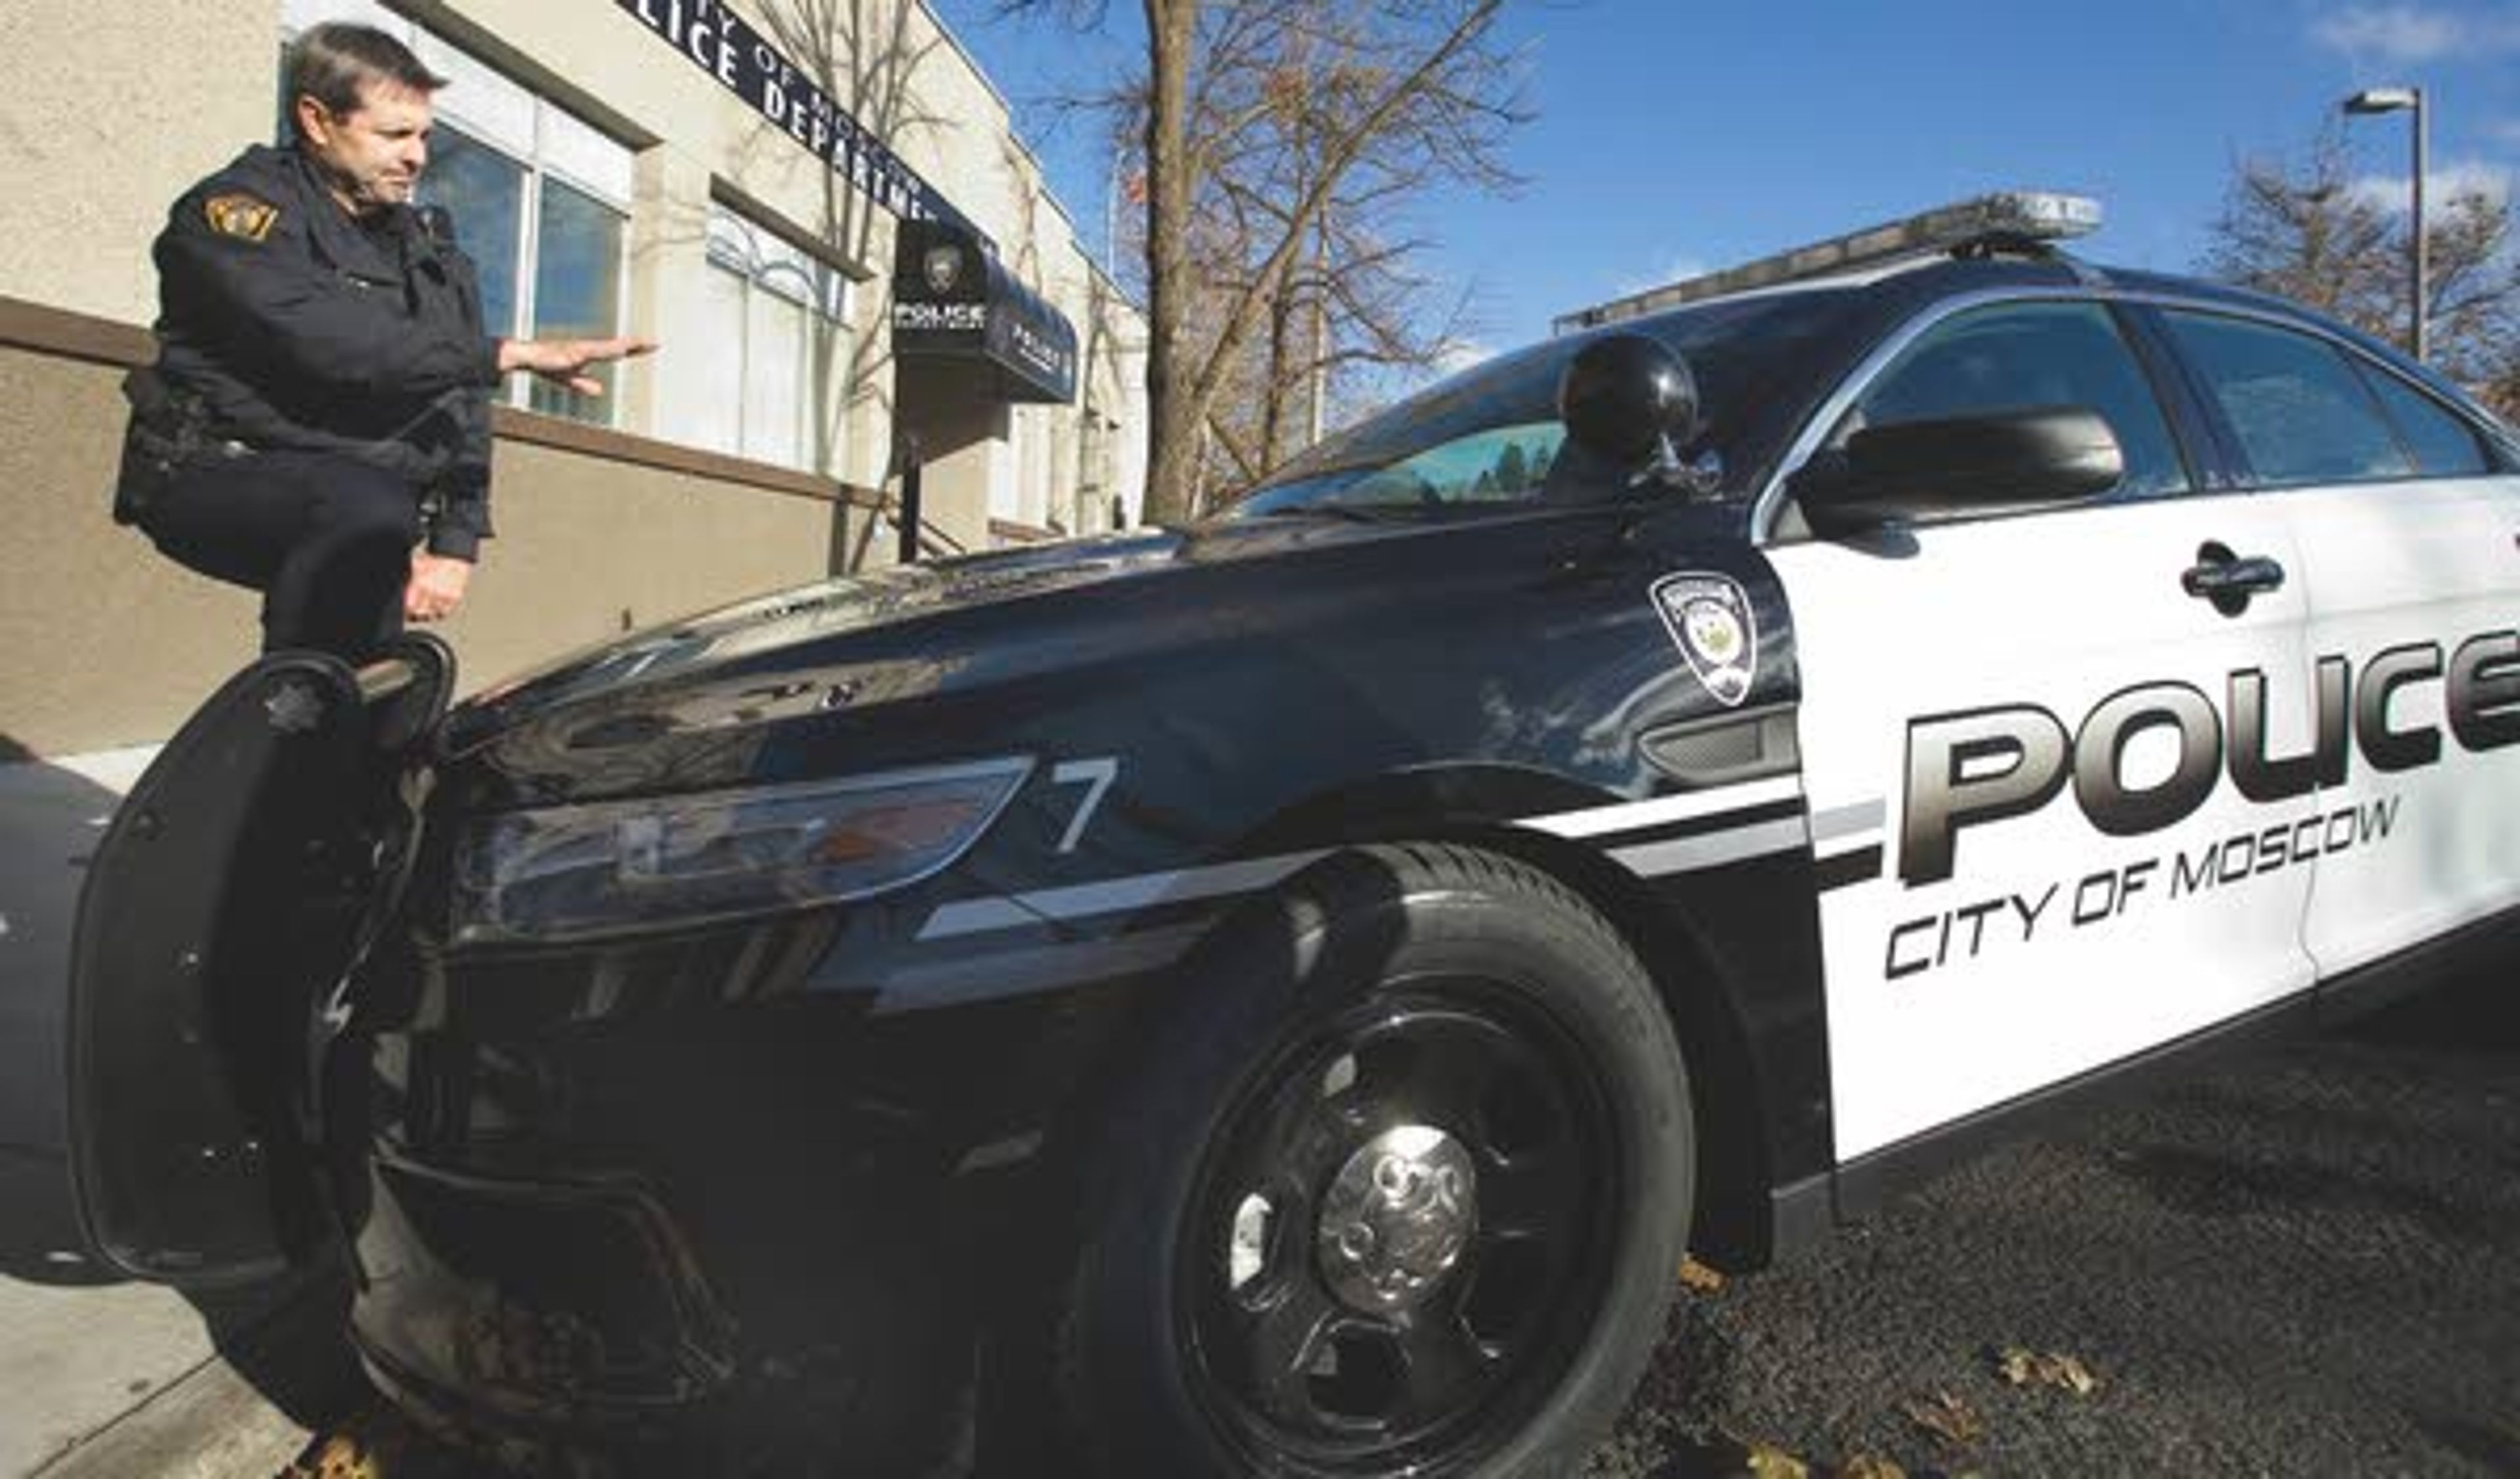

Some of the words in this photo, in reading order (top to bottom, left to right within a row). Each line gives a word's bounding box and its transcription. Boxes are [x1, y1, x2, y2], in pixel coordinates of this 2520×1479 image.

[756, 44, 794, 86] OF
[894, 303, 986, 322] POLICE
[1053, 757, 1118, 853] 7
[1898, 628, 2520, 888] POLICE
[1885, 884, 2059, 980] CITY
[2072, 857, 2158, 926] OF
[2171, 795, 2401, 899] MOSCOW
